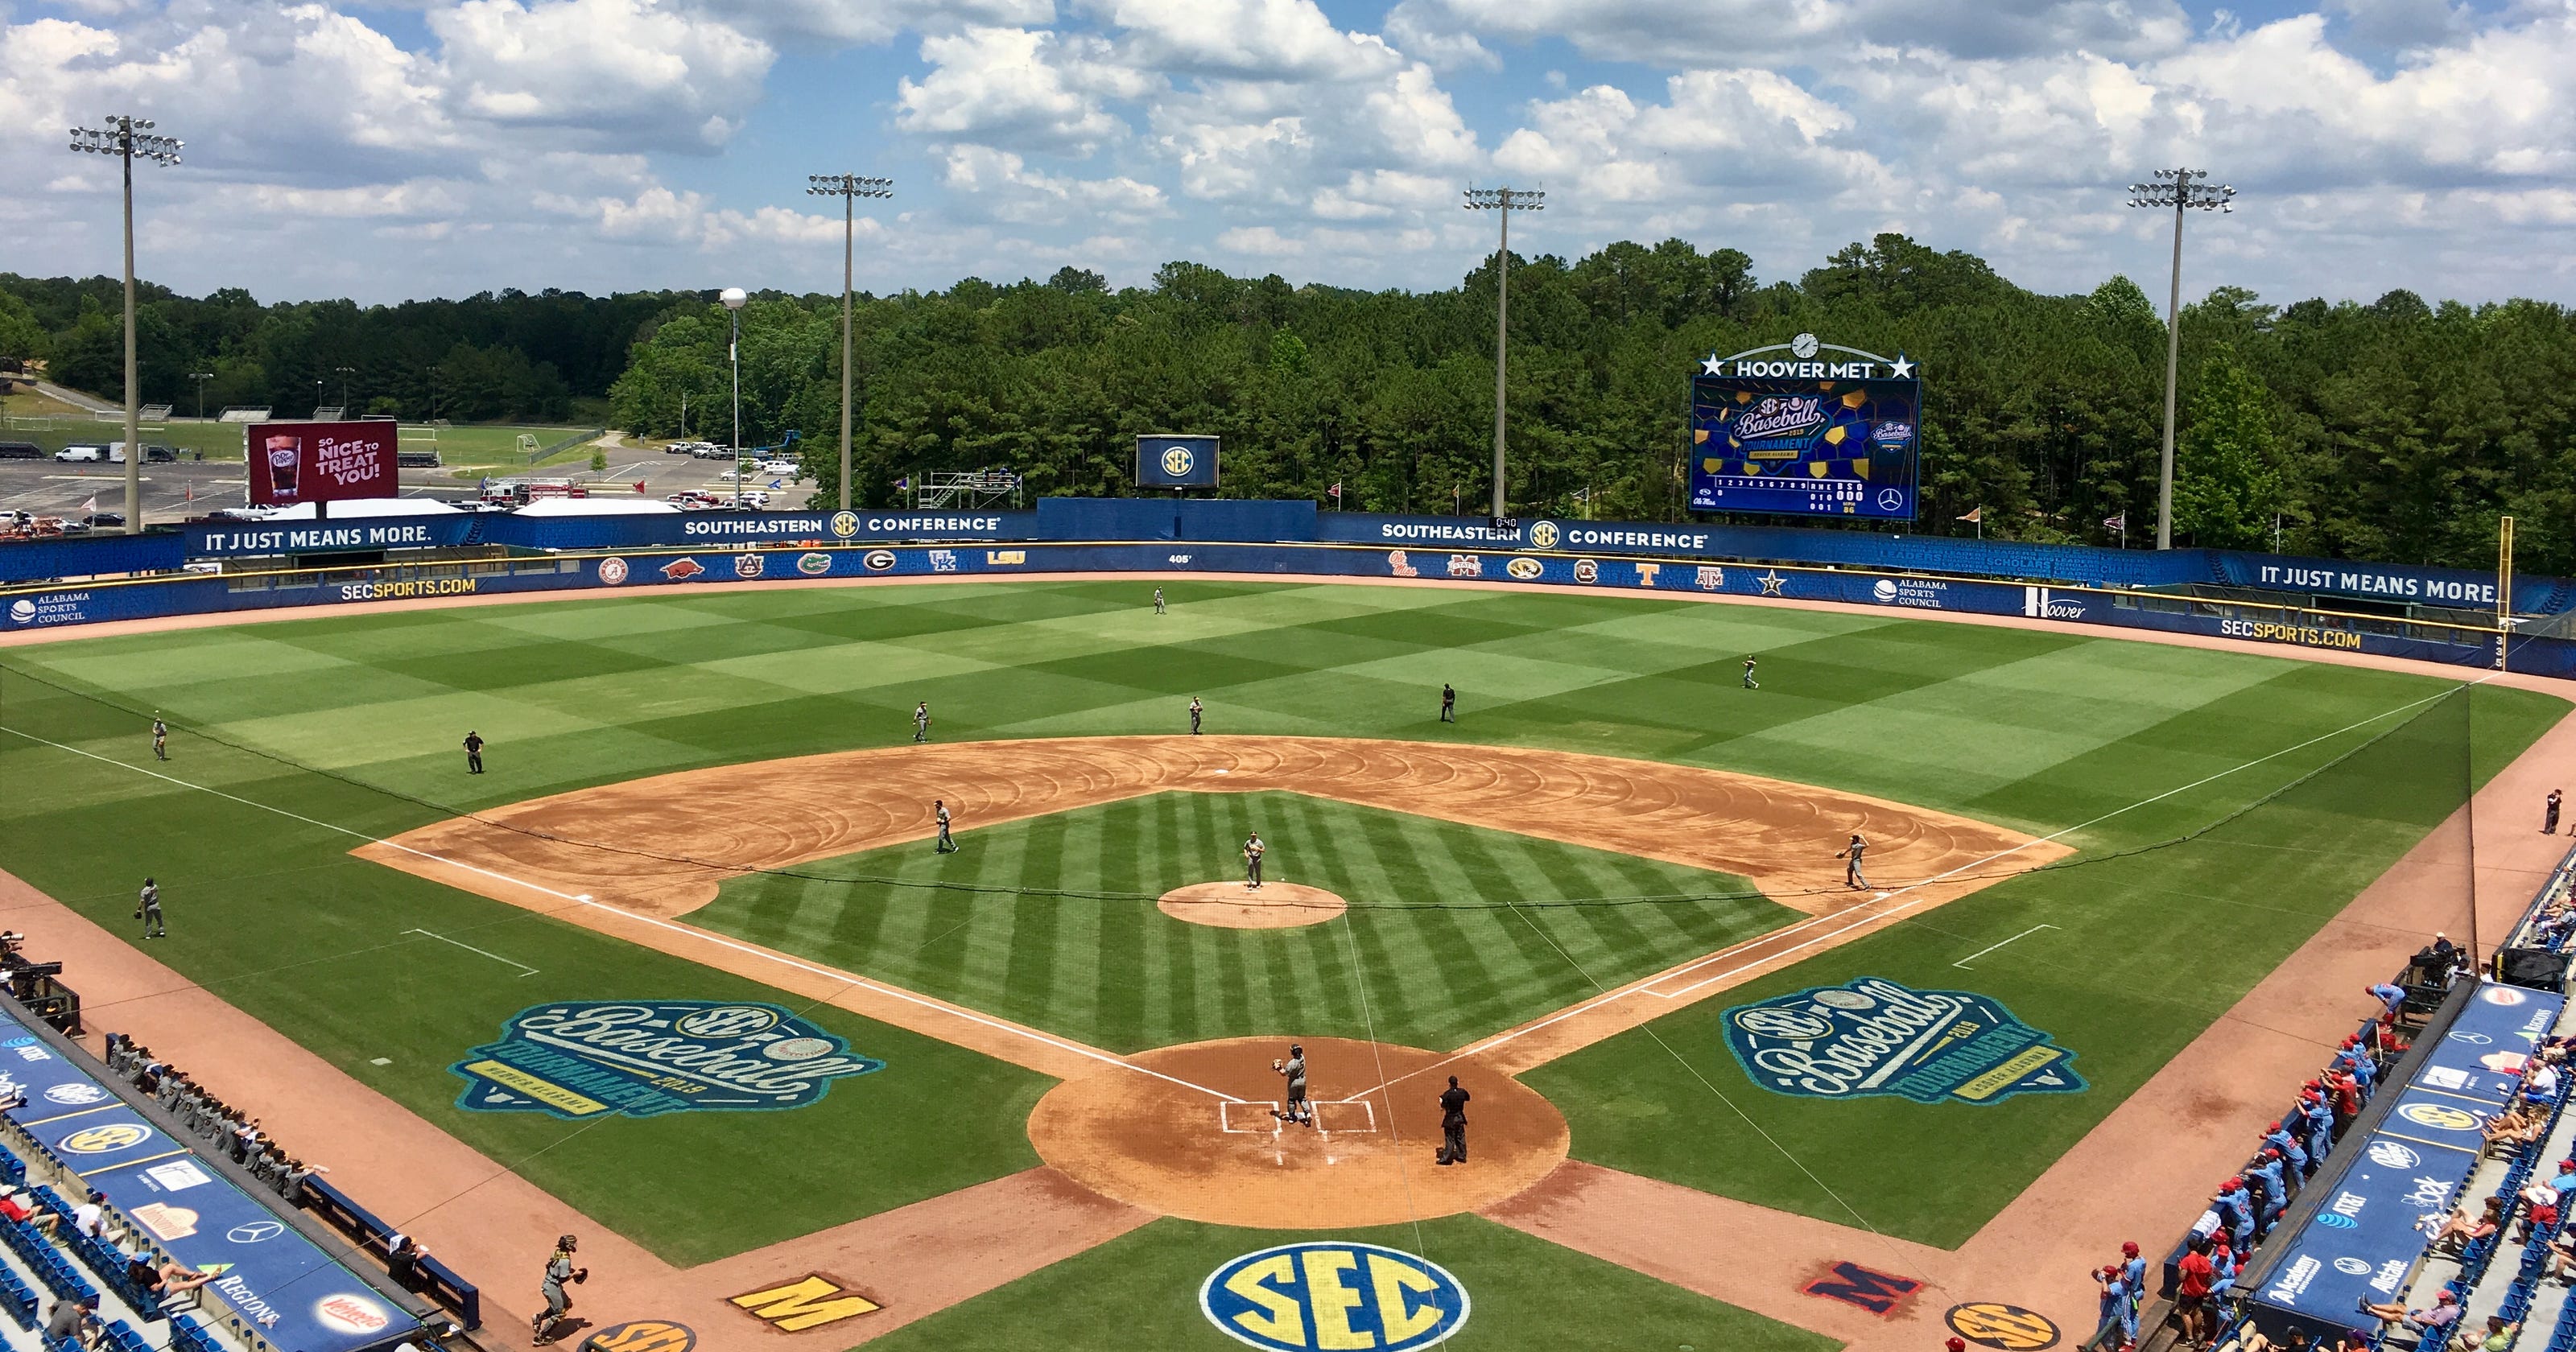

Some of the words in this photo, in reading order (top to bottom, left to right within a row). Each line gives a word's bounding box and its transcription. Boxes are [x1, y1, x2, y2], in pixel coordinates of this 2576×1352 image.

[1737, 361, 1825, 378] HOOVER
[1830, 363, 1874, 379] MET
[1761, 398, 1777, 414] SEC
[1735, 398, 1821, 437] Baseball
[318, 437, 334, 447] SO
[318, 439, 363, 461] NICE
[365, 443, 379, 452] TO
[1743, 438, 1810, 451] TOURNAMENT
[316, 451, 378, 476] TREAT
[1166, 450, 1190, 473] SEC
[334, 464, 380, 485] YOU!
[685, 519, 822, 534] SOUTHEASTERN
[833, 513, 857, 535] SEC
[1496, 518, 1517, 528] 0:40
[206, 534, 225, 550] IT
[229, 531, 283, 550] JUST
[290, 529, 361, 547] MEANS
[369, 526, 431, 544] MORE.
[1533, 523, 1556, 546] SEC
[987, 550, 1026, 565] LSU
[1169, 554, 1191, 563] 405'
[1389, 550, 1406, 564] Ole
[1880, 549, 1942, 562] LEADERS
[1987, 558, 2051, 570] SCHOLARS
[1393, 563, 1418, 577] Miss
[341, 579, 476, 600] SECSPORTS.COM
[1899, 579, 1947, 590] ALABAMA
[1899, 588, 1934, 598] SPORTS
[2261, 566, 2280, 583] IT
[2283, 568, 2334, 588] JUST
[2340, 573, 2418, 596] MEANS
[2426, 579, 2499, 603] MORE.
[38, 592, 89, 604] ALABAMA
[38, 603, 76, 613] SPORTS
[1899, 596, 1941, 608] COUNCIL
[2021, 587, 2086, 618] Hoover
[38, 612, 85, 624] COUNCIL
[2222, 620, 2360, 649] SECSPORTS.COM
[681, 1008, 776, 1037] SEC
[1740, 1008, 1825, 1037] SEC
[1947, 1021, 1980, 1039] 2019
[2522, 1008, 2553, 1033] REGIONS
[1754, 979, 1964, 1094] Baseball
[14, 1045, 52, 1062] AT&T
[518, 1006, 865, 1094] Baseball
[1886, 1023, 2041, 1098] TOURNAMENT
[485, 1040, 690, 1113] TOURNAMENT
[1971, 1071, 2010, 1093] HOOVER
[2007, 1052, 2047, 1075] ALABAMA
[485, 1067, 534, 1087] HOOVER
[530, 1086, 589, 1109] ALABAMA
[650, 1078, 708, 1094] 2019
[2332, 1191, 2368, 1218] AT&T
[2275, 1254, 2319, 1299] Academy
[2370, 1259, 2408, 1295] Allstate
[214, 1275, 280, 1322] REGIONS
[1802, 1260, 1924, 1316] M
[726, 1273, 884, 1333] M
[1224, 1250, 1444, 1350] SEC
